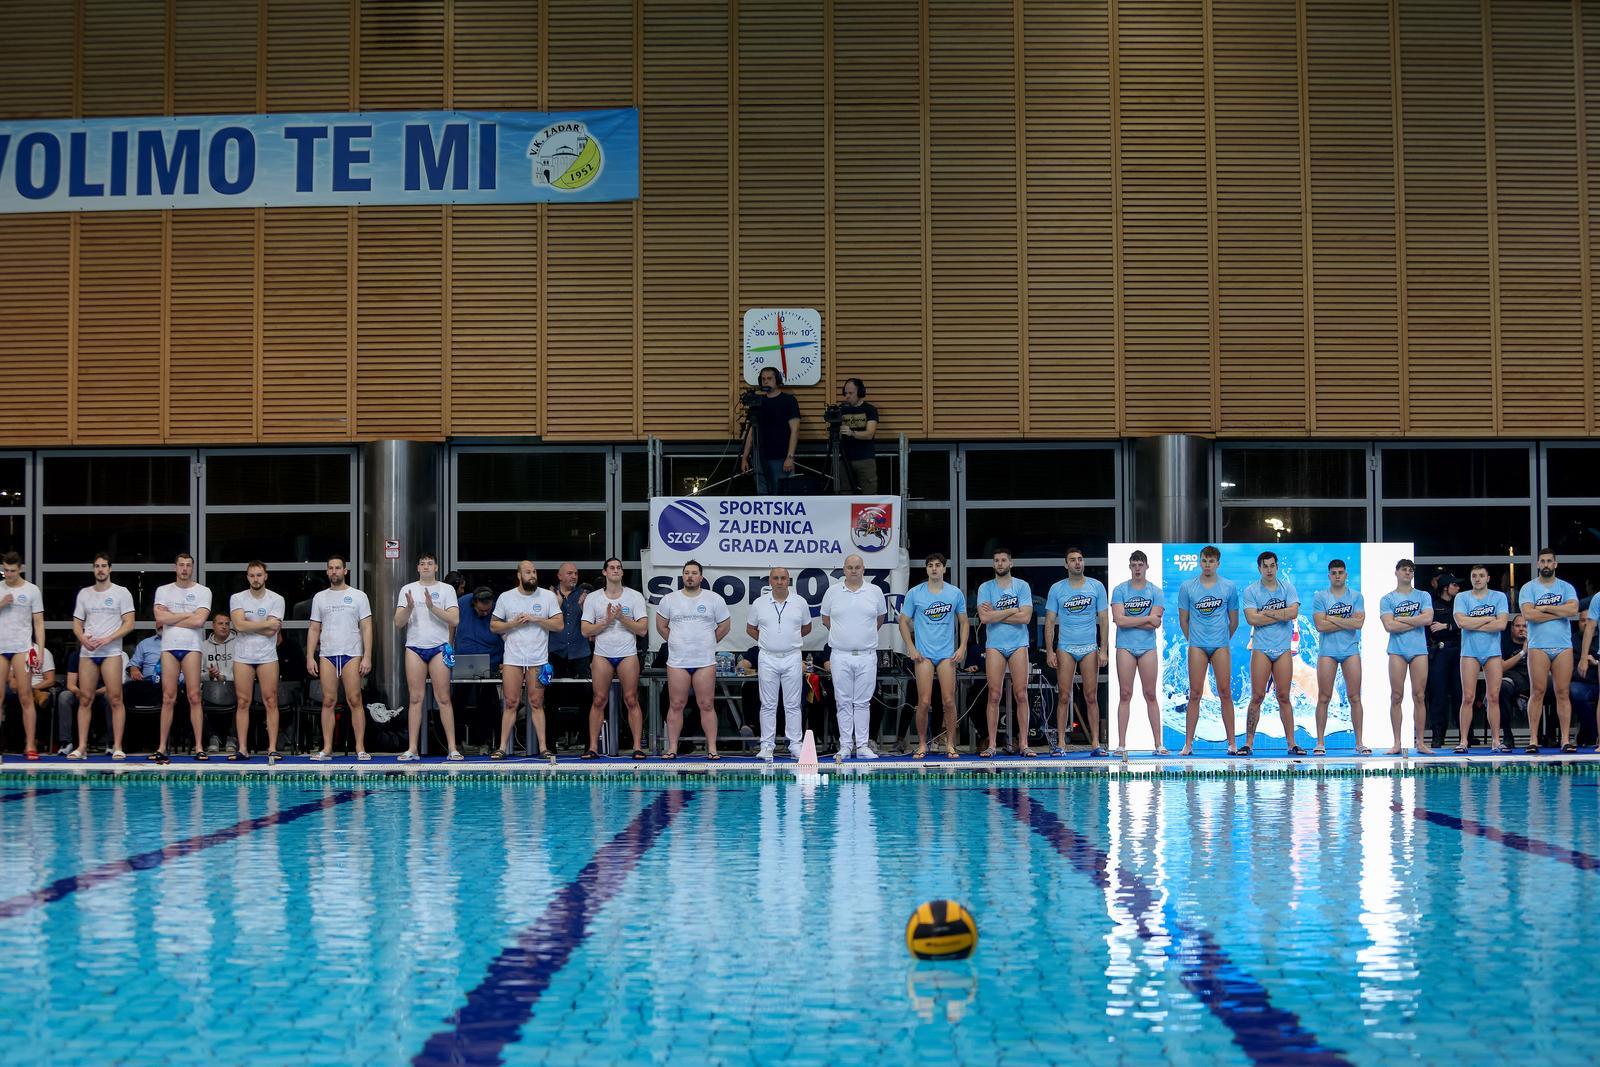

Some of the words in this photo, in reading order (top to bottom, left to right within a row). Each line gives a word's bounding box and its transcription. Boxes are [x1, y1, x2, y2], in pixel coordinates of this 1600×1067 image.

[544, 124, 580, 138] ZADAR
[284, 125, 372, 192] TE
[404, 123, 496, 190] MI
[570, 163, 594, 181] 1952
[719, 501, 806, 516] SPORTSKA
[719, 519, 814, 535] ZAJEDNICA
[667, 532, 700, 544] SZGZ
[719, 538, 779, 553] GRADA
[783, 539, 842, 554] ZADRA
[1180, 554, 1198, 562] CRO
[208, 653, 233, 661] BOSS
